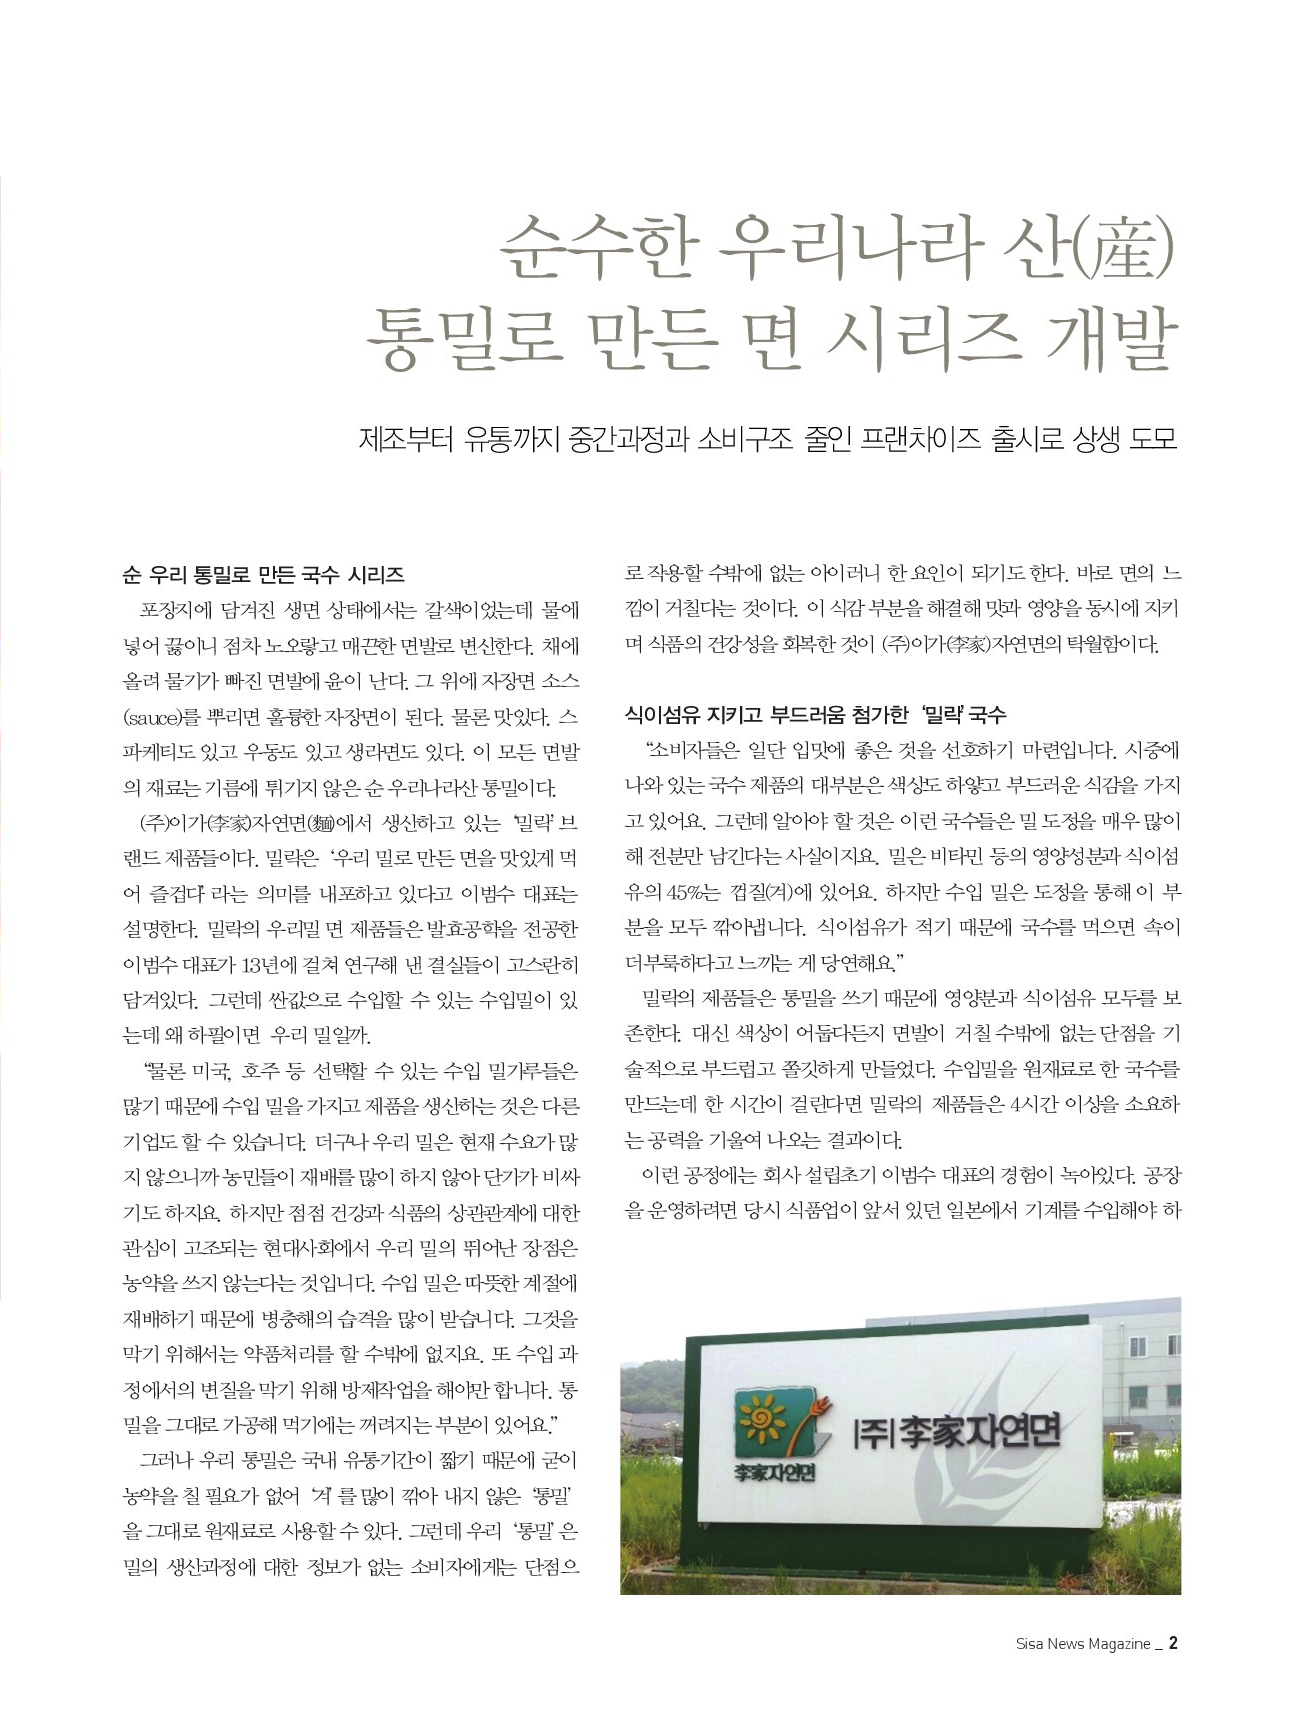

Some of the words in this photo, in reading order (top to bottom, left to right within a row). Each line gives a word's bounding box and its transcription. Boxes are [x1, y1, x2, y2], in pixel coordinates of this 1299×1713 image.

[499, 212, 701, 282] 순수한
[718, 212, 986, 282] 우리나라
[366, 304, 565, 373] 통밀로
[587, 304, 720, 371] 만든
[741, 304, 802, 371] 면
[827, 304, 1024, 374] 시리즈
[1047, 304, 1180, 374] 개발
[358, 425, 453, 454] 제조부터
[464, 425, 560, 454] 유통까지
[568, 425, 691, 454] 중간과정과
[697, 425, 794, 454] 소비구조
[804, 425, 852, 453] 줄인
[860, 425, 982, 453] 프랜차이즈
[991, 425, 1065, 454] 출시로
[1072, 425, 1120, 454] 상생
[1129, 427, 1178, 450] 도모
[121, 564, 143, 585] 순
[149, 565, 187, 586] 우리
[193, 565, 252, 586] 통밀로
[258, 565, 297, 585] 만든
[301, 565, 341, 585] 국수
[347, 565, 406, 586] 시리즈
[139, 600, 212, 621] 포장지에
[220, 600, 276, 620] 담겨진
[283, 600, 321, 621] 생면
[325, 600, 418, 621] 상태에서는
[424, 600, 533, 621] 갈색이었는데
[540, 600, 579, 620] 물에
[624, 705, 702, 726] 식이섬유
[706, 705, 764, 726] 지키고
[769, 704, 847, 726] 부드러움
[851, 704, 910, 726] 첨가한
[968, 705, 1008, 725] 국수
[122, 742, 197, 763] 파케티도
[200, 742, 239, 763] 있고
[242, 742, 299, 763] 우동도
[305, 742, 343, 763] 있고
[345, 742, 420, 763] 생라면도
[425, 742, 465, 763] 있다.
[473, 742, 490, 763] 이
[497, 743, 537, 762] 모든
[542, 742, 581, 762] 면발
[748, 740, 787, 760] 일단
[792, 740, 845, 761] 입맛에
[853, 740, 893, 761] 좋은
[898, 740, 937, 761] 것을
[941, 740, 1013, 761] 선호하기
[1022, 740, 1117, 761] 마련입니다.
[1124, 740, 1179, 761] 시중에
[122, 919, 199, 940] 설명한다.
[207, 919, 260, 940] 밀락의
[265, 919, 321, 940] 우리밀
[325, 919, 344, 939] 면
[350, 919, 424, 939] 제품들은
[426, 919, 518, 940] 발효공학을
[523, 919, 579, 940] 전공한
[623, 917, 664, 937] 분을
[668, 918, 708, 937] 모두
[712, 917, 807, 938] 깎아냅니다.
[816, 917, 908, 938] 식이섬유가
[915, 917, 951, 937] 적기
[958, 917, 1012, 938] 때문에
[1020, 917, 1077, 937] 국수를
[1082, 917, 1136, 937] 먹으면
[1143, 917, 1180, 938] 속이
[642, 1165, 680, 1186] 이런
[683, 1165, 758, 1186] 공정에는
[762, 1165, 803, 1186] 회사
[804, 1165, 876, 1185] 설립초기
[882, 1165, 937, 1186] 이범수
[941, 1165, 995, 1186] 대표의
[1000, 1165, 1053, 1186] 경험이
[1059, 1165, 1136, 1186] 녹아있다.
[1143, 1165, 1183, 1186] 공장
[121, 1238, 176, 1259] 관심이
[183, 1238, 258, 1259] 고조되는
[262, 1238, 369, 1259] 현대사회에서
[375, 1238, 413, 1259] 우리
[419, 1238, 456, 1259] 밀의
[462, 1238, 518, 1259] 뛰어난
[522, 1238, 579, 1259] 장점은
[123, 1557, 158, 1578] 밀의
[166, 1557, 256, 1578] 생산과정에
[263, 1557, 299, 1578] 대한
[306, 1557, 362, 1578] 정보가
[367, 1557, 404, 1577] 없는
[410, 1557, 518, 1578] 소비자에게는
[524, 1557, 581, 1577] 단점으
[1016, 1637, 1044, 1650] Sisa
[1047, 1637, 1085, 1650] News
[1088, 1637, 1151, 1654] Magazine
[1168, 1635, 1178, 1650] 2
